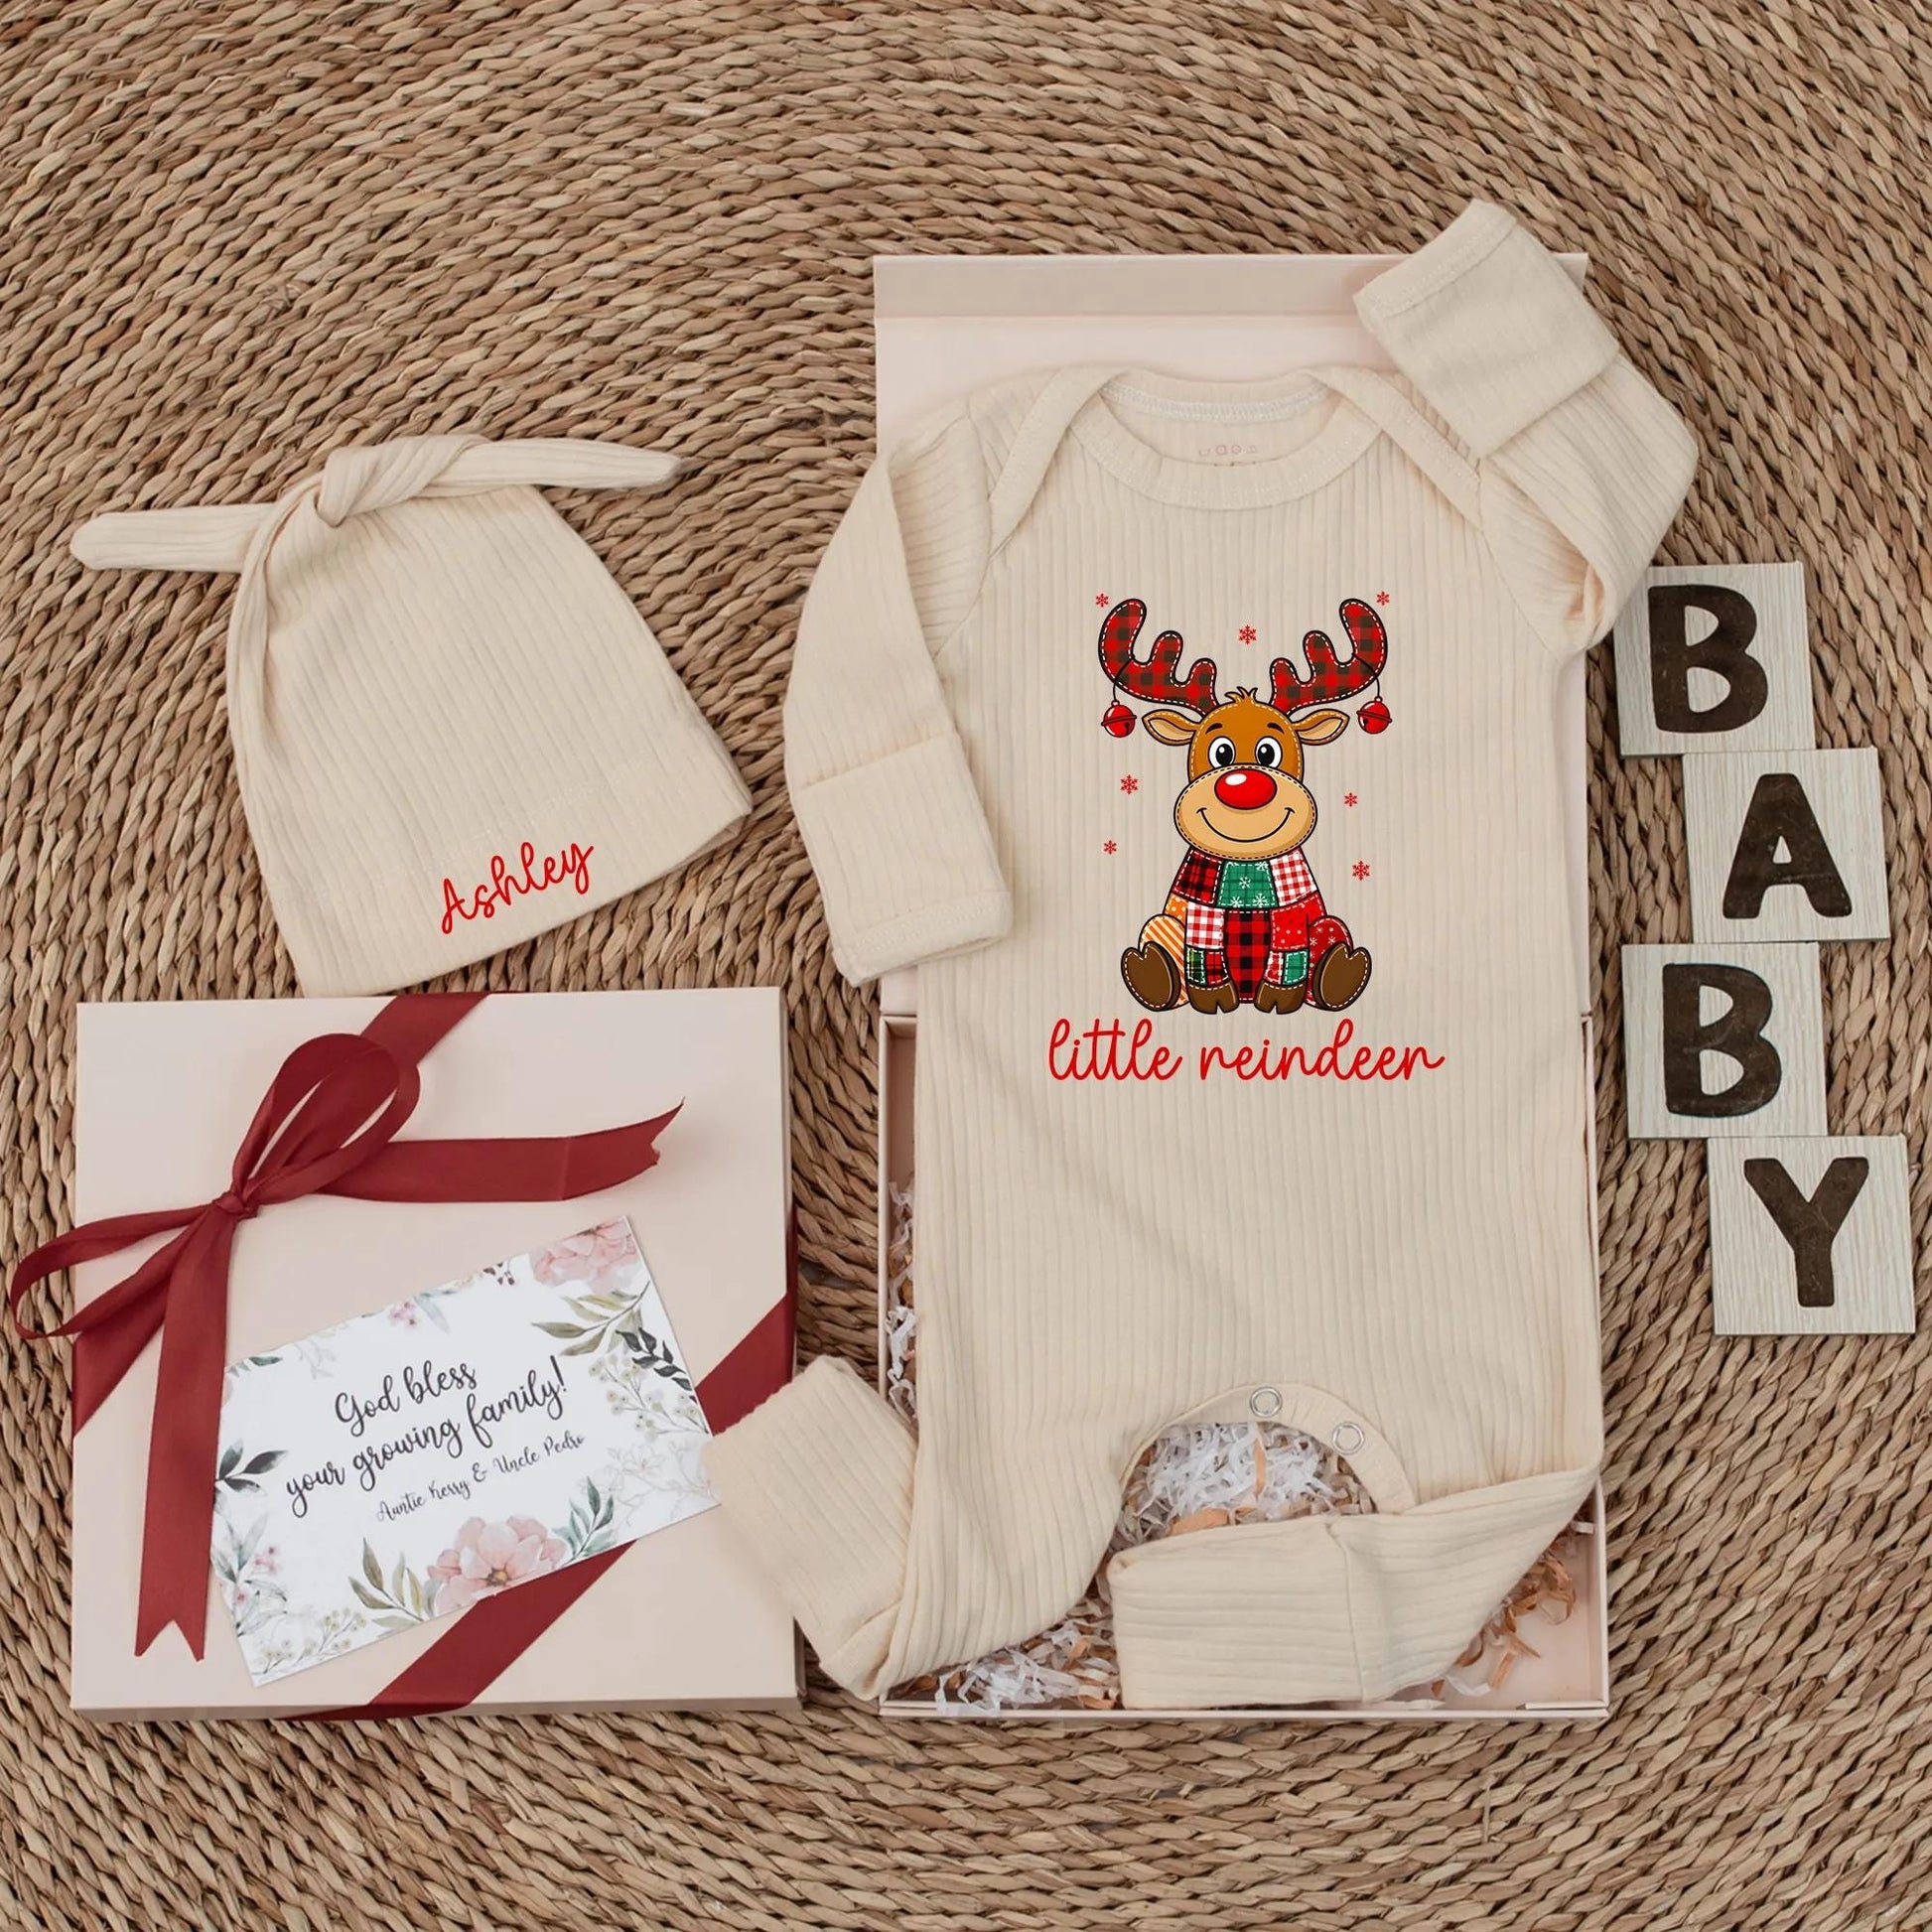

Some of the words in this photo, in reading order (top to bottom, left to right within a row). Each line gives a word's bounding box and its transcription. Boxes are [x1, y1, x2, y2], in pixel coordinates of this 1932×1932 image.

[441, 841, 594, 935] Ashley
[1048, 1018, 1183, 1081] little
[1199, 1018, 1446, 1081] reindeer
[285, 1461, 346, 1518] your
[352, 1418, 463, 1491] growing
[466, 1354, 568, 1449] family!
[336, 1374, 400, 1437] God
[404, 1359, 478, 1405] bless
[377, 1493, 426, 1522] Auntie
[429, 1479, 471, 1500] Kerry
[472, 1461, 487, 1483] &
[492, 1446, 539, 1474] Uncle
[543, 1430, 586, 1457] Pedro
